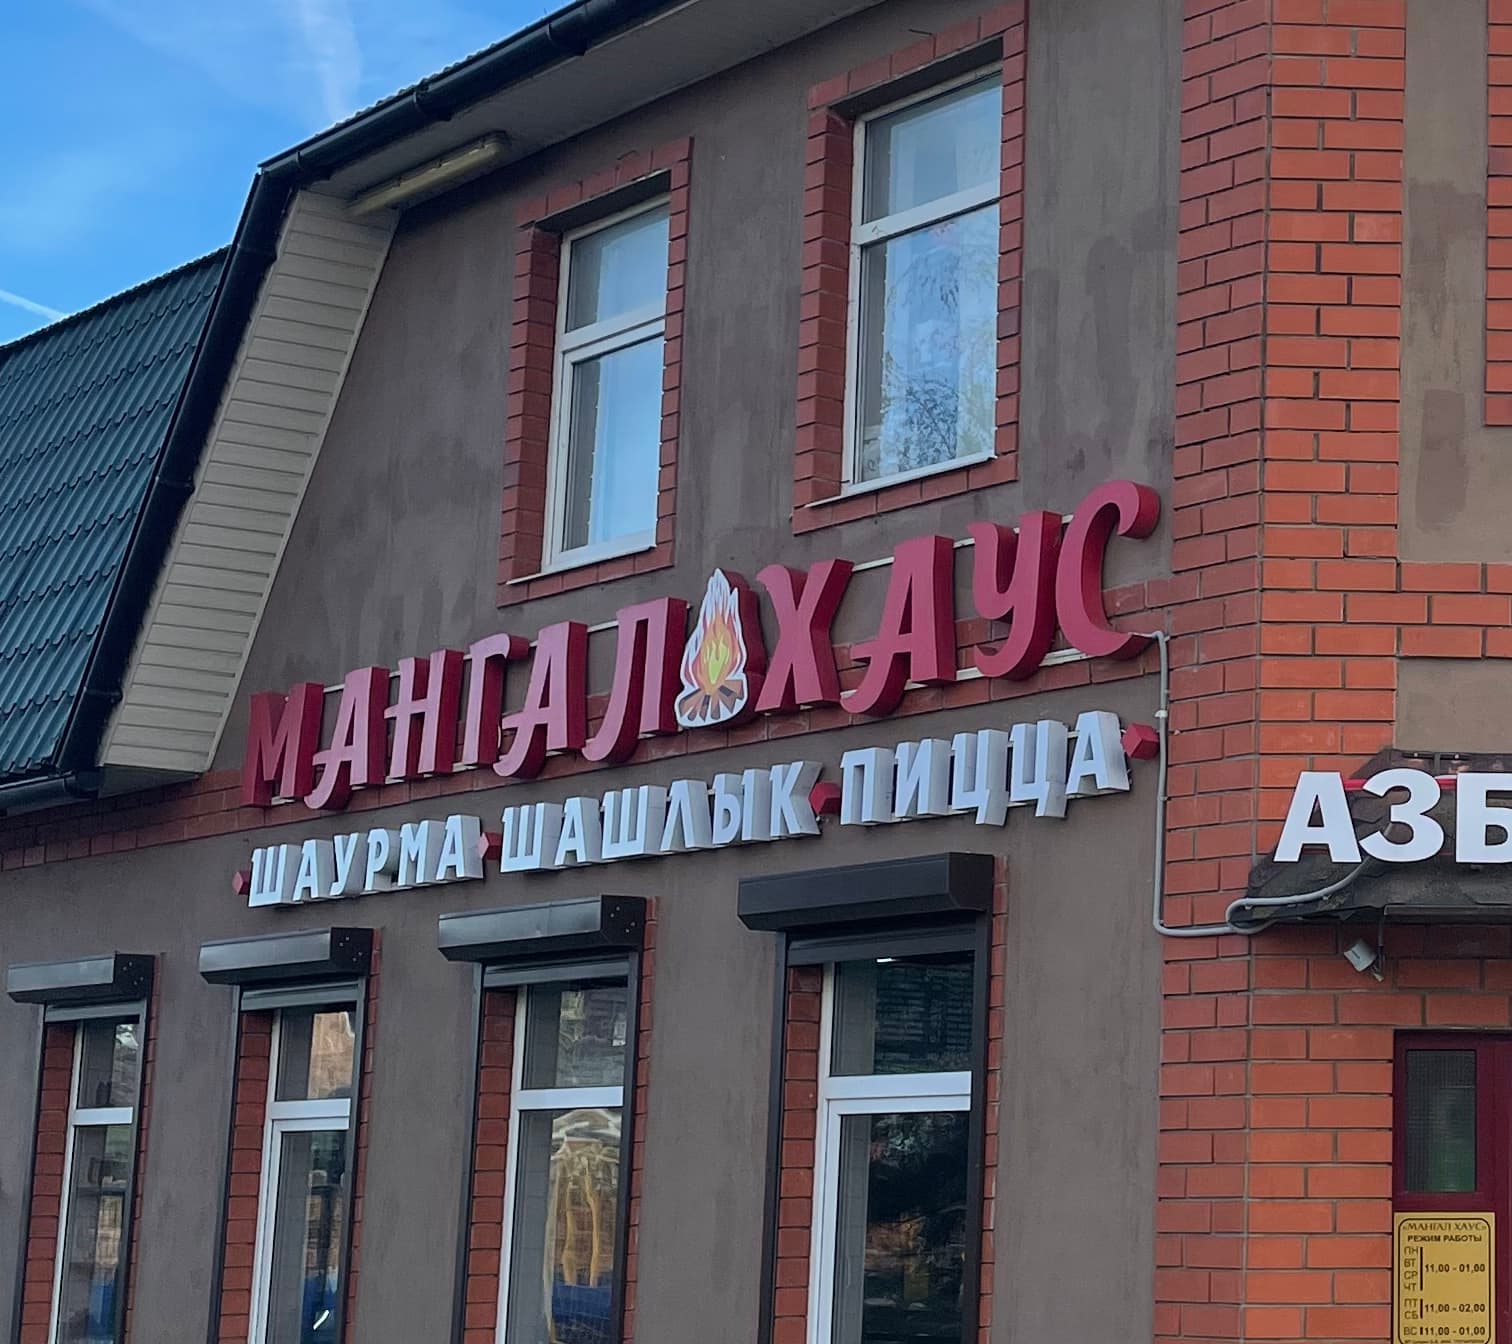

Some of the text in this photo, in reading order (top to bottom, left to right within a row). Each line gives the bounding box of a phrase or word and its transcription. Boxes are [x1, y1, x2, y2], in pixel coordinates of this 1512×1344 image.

[240, 479, 1161, 810] МАНГАЛ ХАУС
[248, 710, 1132, 908] ШАУРМА ШАШЛЫК ПИЦЦА
[1407, 1234, 1483, 1243] РЕЖИМ РАБОТЫ
[1403, 1246, 1419, 1255] ПН
[1403, 1258, 1417, 1268] ВТ
[1403, 1270, 1418, 1280] СР
[1403, 1282, 1417, 1292] ЧТ
[1403, 1298, 1419, 1307] ПТ
[1403, 1310, 1419, 1320] СБ
[1403, 1326, 1418, 1336] ВС
